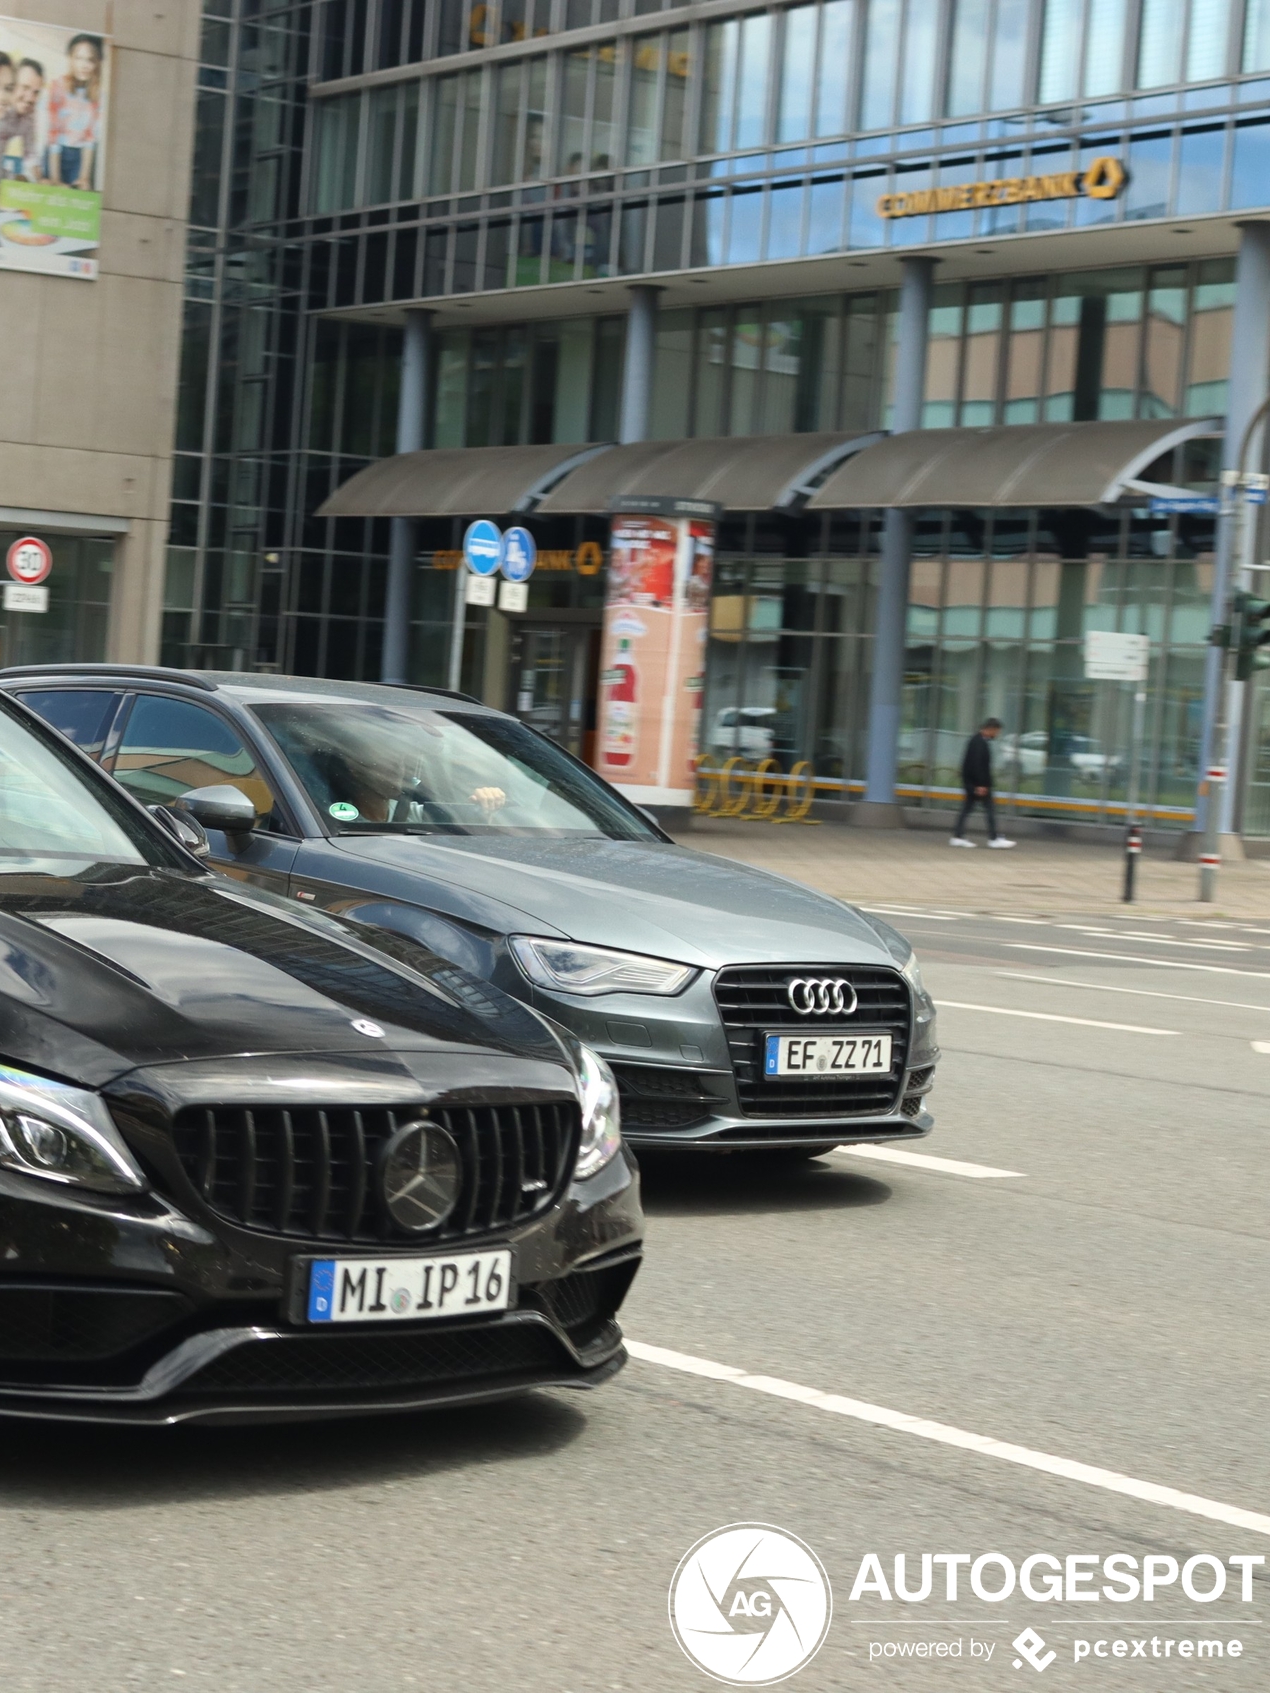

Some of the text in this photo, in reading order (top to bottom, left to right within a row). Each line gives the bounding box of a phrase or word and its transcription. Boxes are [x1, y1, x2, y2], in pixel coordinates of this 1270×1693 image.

[877, 171, 1082, 219] COMMERZBANK
[17, 550, 43, 571] 30
[339, 804, 348, 812] 4
[787, 1040, 817, 1070] EF
[340, 1267, 387, 1313] MI
